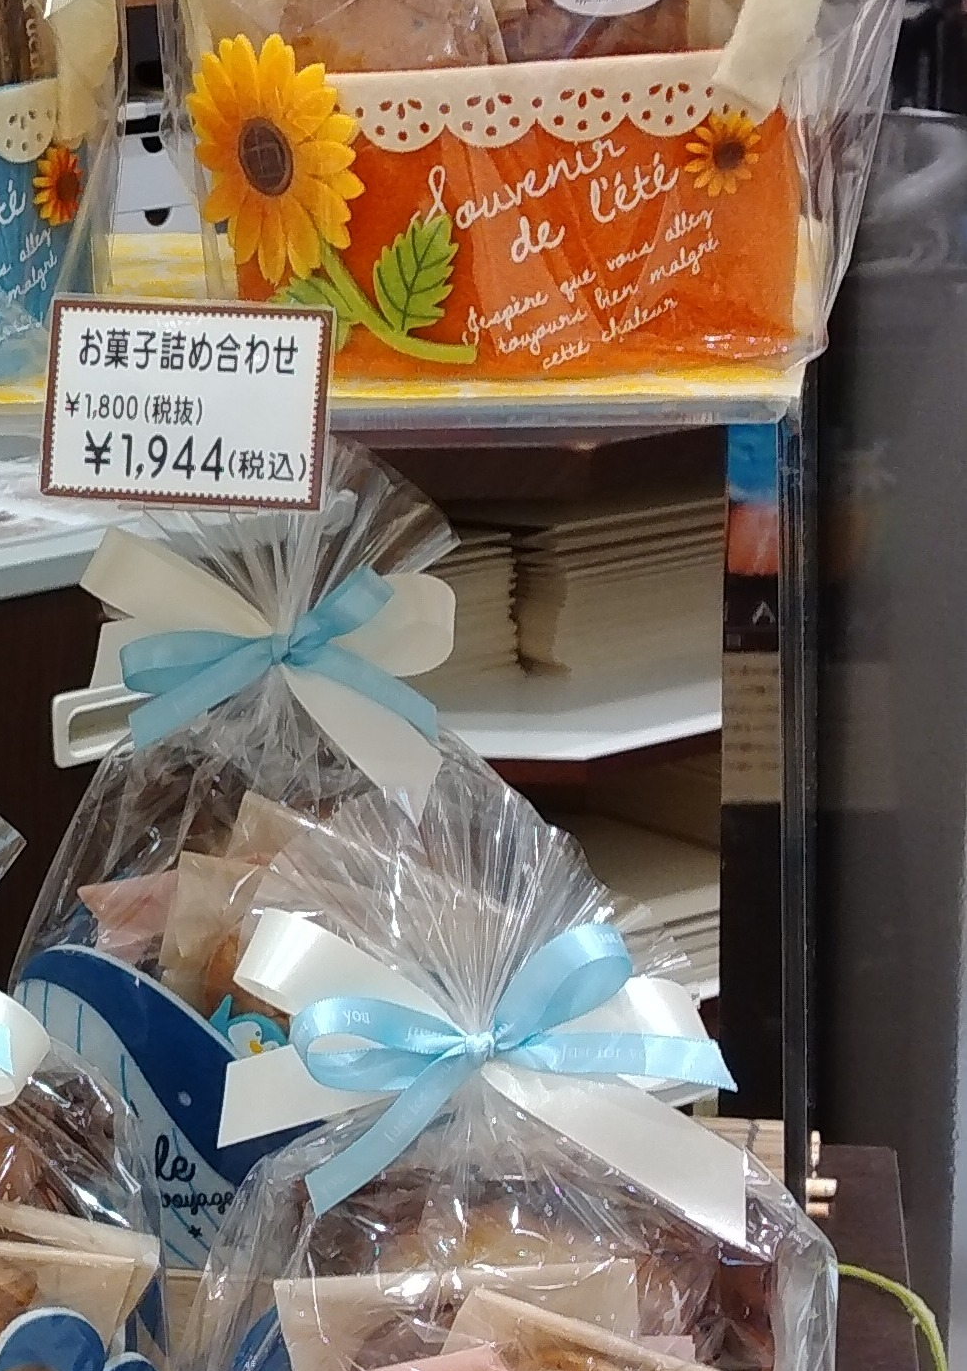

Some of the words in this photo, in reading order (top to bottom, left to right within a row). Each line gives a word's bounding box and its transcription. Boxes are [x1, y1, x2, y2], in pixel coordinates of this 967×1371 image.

[411, 135, 627, 230] Souvenir
[590, 151, 680, 223] l'été
[510, 215, 565, 264] de
[560, 267, 597, 305] que
[606, 239, 656, 272] vous
[664, 207, 715, 243] allez
[497, 308, 589, 357] toujours
[594, 279, 640, 310] bien
[649, 232, 720, 285] malgré
[78, 326, 299, 375] お菓子詰め合わせ
[542, 339, 591, 371] cette
[601, 296, 680, 343] chaleur
[342, 1009, 372, 1026] you
